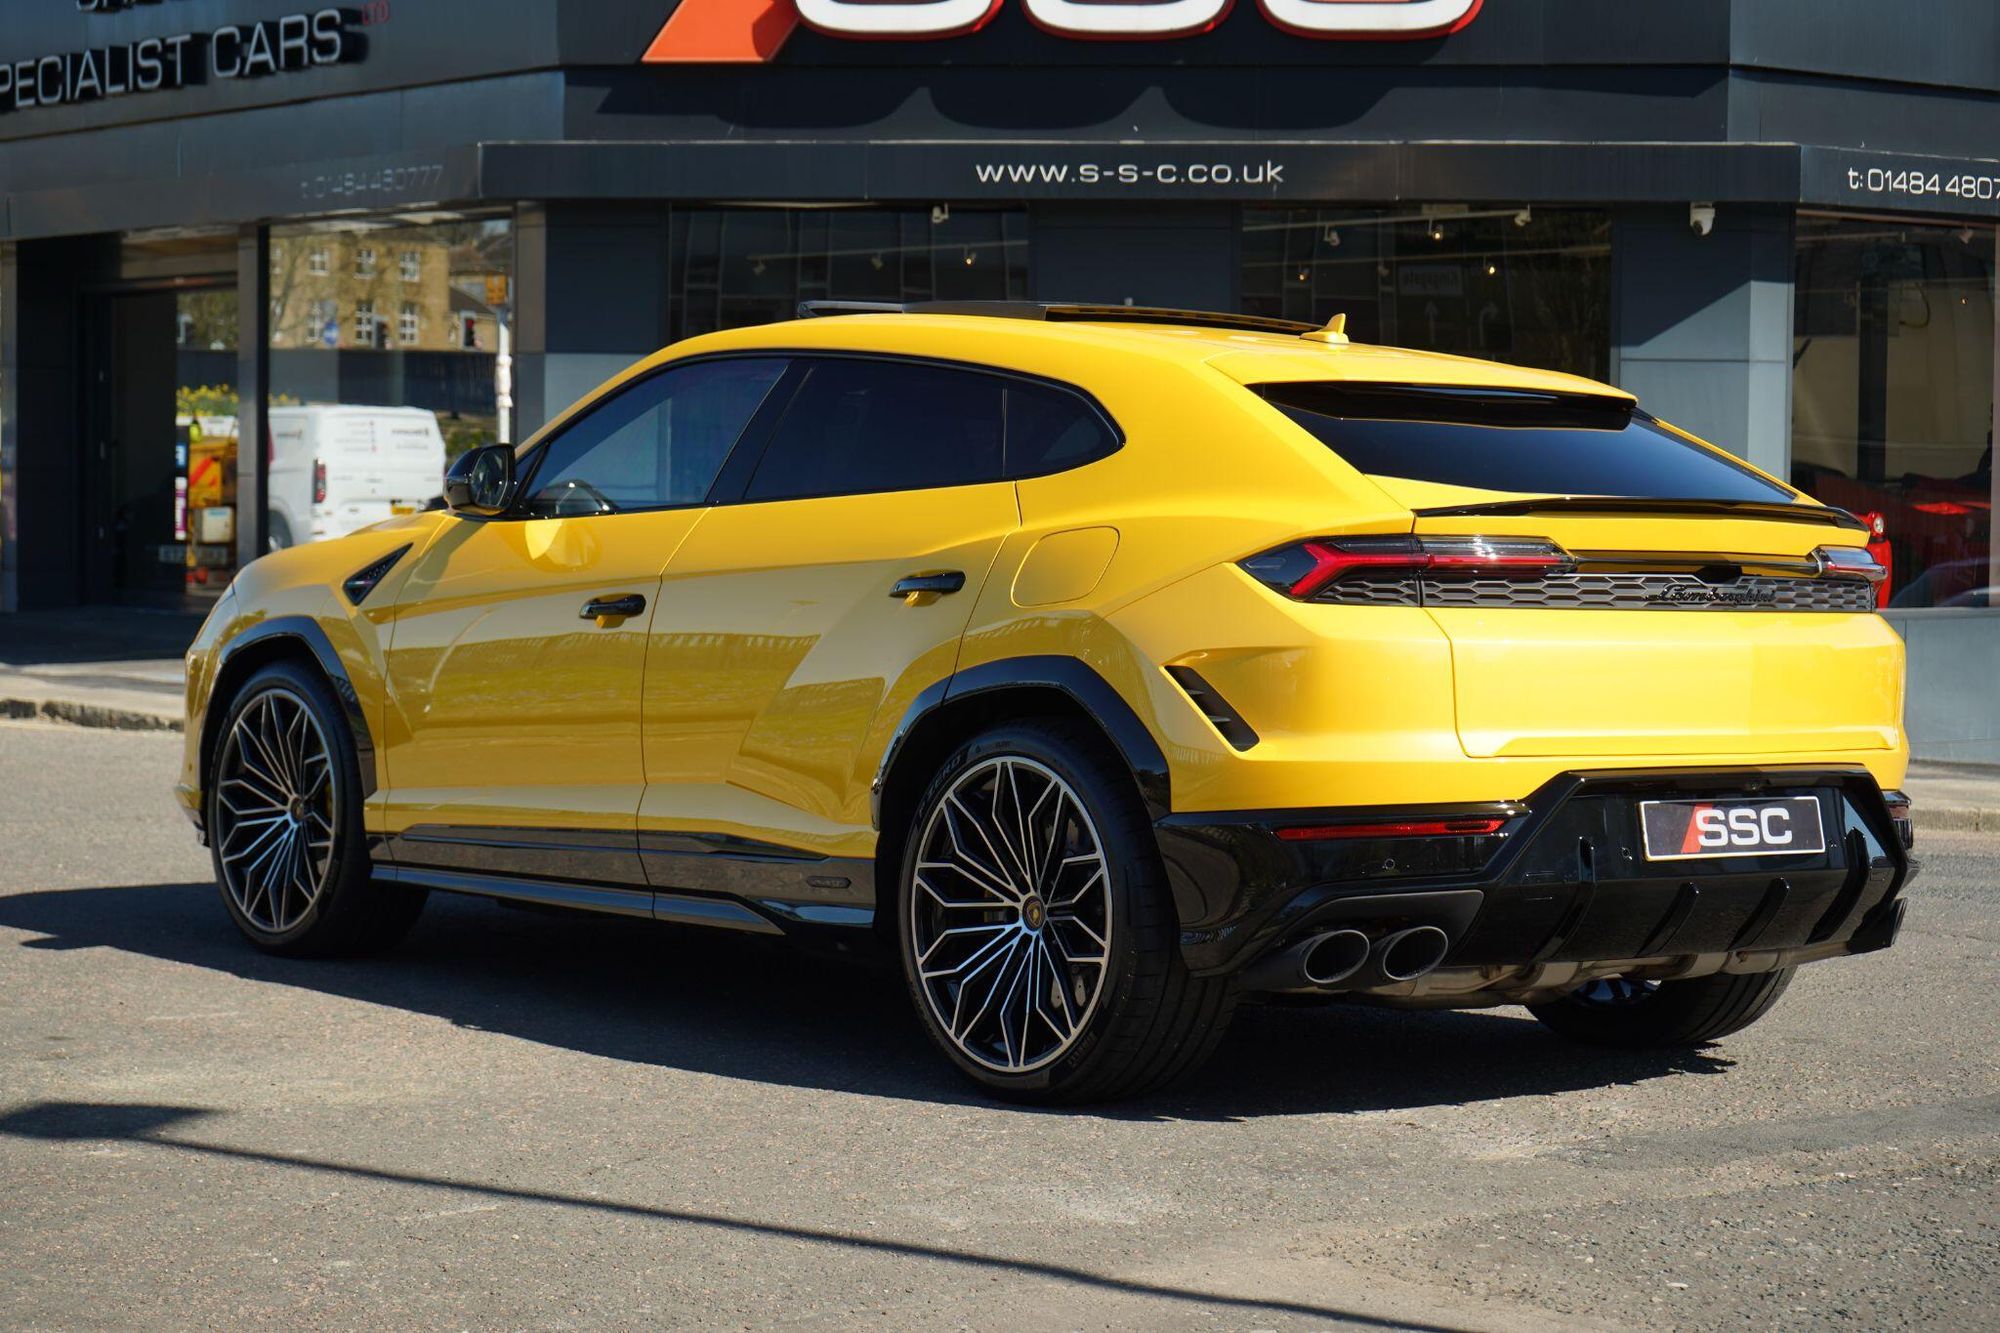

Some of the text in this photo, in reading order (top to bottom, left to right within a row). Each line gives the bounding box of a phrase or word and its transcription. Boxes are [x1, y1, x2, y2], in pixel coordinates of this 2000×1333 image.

[212, 8, 342, 78] CARS
[361, 1, 390, 25] LTD
[975, 160, 1284, 183] www.s-s-c.co.uk
[1695, 807, 1793, 847] SSC
